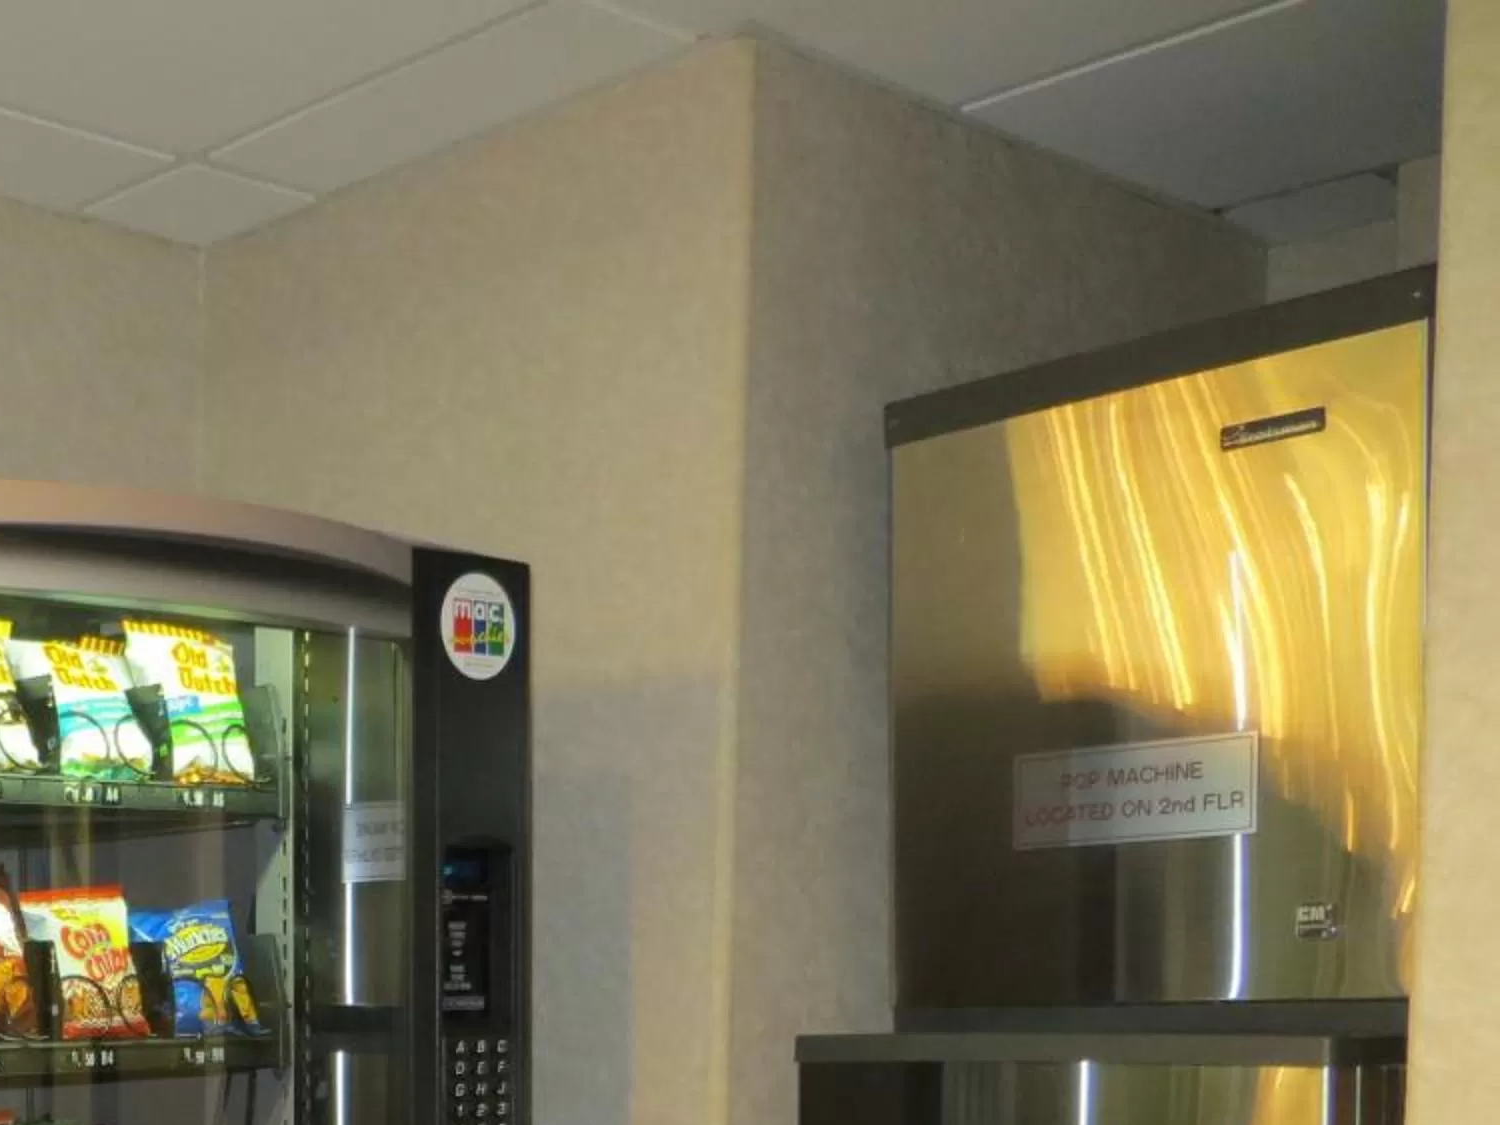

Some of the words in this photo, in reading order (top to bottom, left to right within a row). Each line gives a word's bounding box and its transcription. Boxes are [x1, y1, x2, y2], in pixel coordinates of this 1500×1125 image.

[45, 644, 84, 669] Old
[172, 643, 208, 668] Old
[179, 667, 236, 694] Dutch
[1060, 772, 1100, 790] POP
[1107, 761, 1205, 786] MACHINE
[1025, 803, 1113, 828] LOCATED
[1121, 799, 1152, 818] ON
[1159, 796, 1195, 815] 2nd
[1202, 790, 1246, 812] FLR
